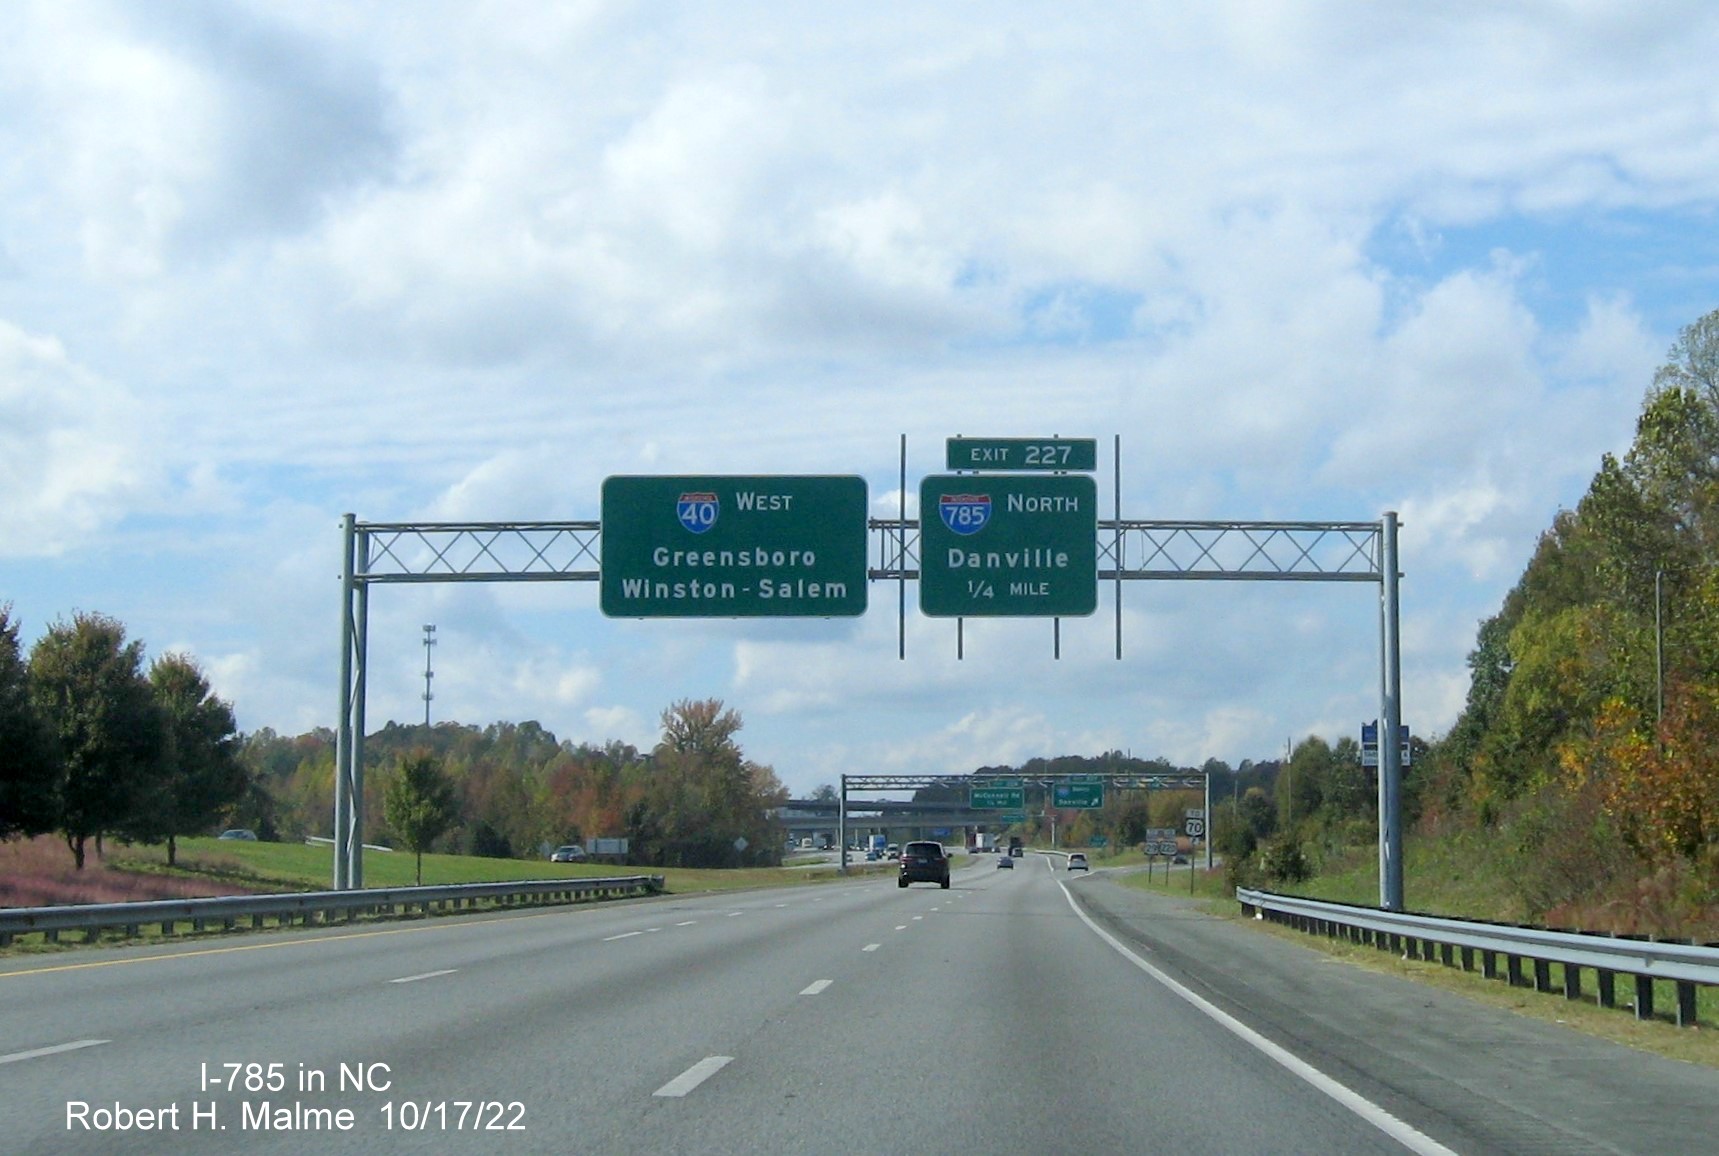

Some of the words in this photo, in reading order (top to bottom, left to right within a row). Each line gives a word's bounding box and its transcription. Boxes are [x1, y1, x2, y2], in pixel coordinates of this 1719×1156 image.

[971, 448, 1009, 461] EXIT
[1025, 446, 1072, 464] 227
[736, 492, 793, 510] WEST
[1007, 494, 1079, 512] NORTH
[681, 503, 716, 525] 40
[945, 506, 985, 525] 785
[653, 547, 816, 567] Greensboro
[948, 548, 1069, 568] Danville
[1009, 582, 1050, 596] MILE
[1188, 822, 1202, 833] 70
